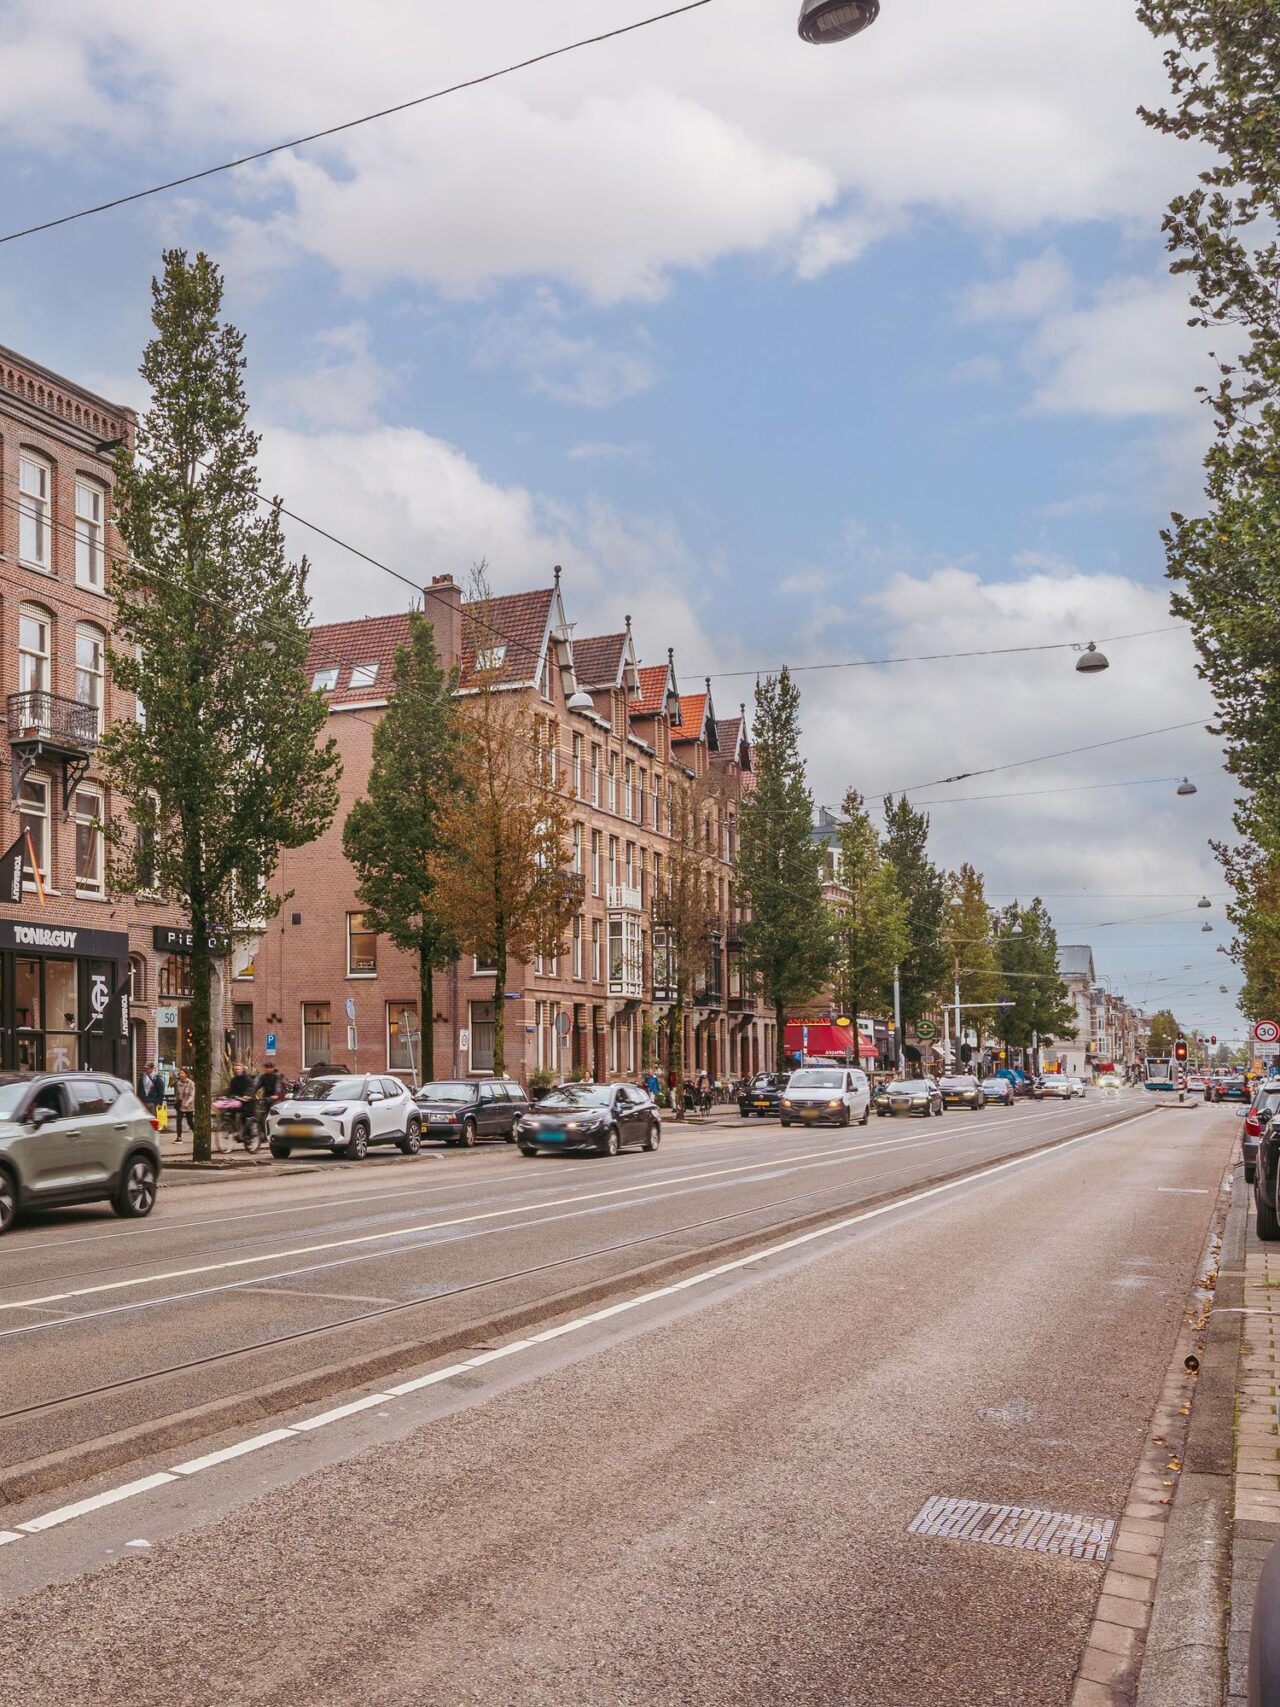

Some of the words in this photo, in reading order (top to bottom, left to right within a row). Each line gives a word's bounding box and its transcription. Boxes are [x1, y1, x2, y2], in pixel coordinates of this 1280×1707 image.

[12, 855, 22, 902] TONI&GUY
[14, 926, 77, 948] TONI&GUY
[121, 994, 129, 1037] TONI&GUY
[1258, 1028, 1275, 1036] 30
